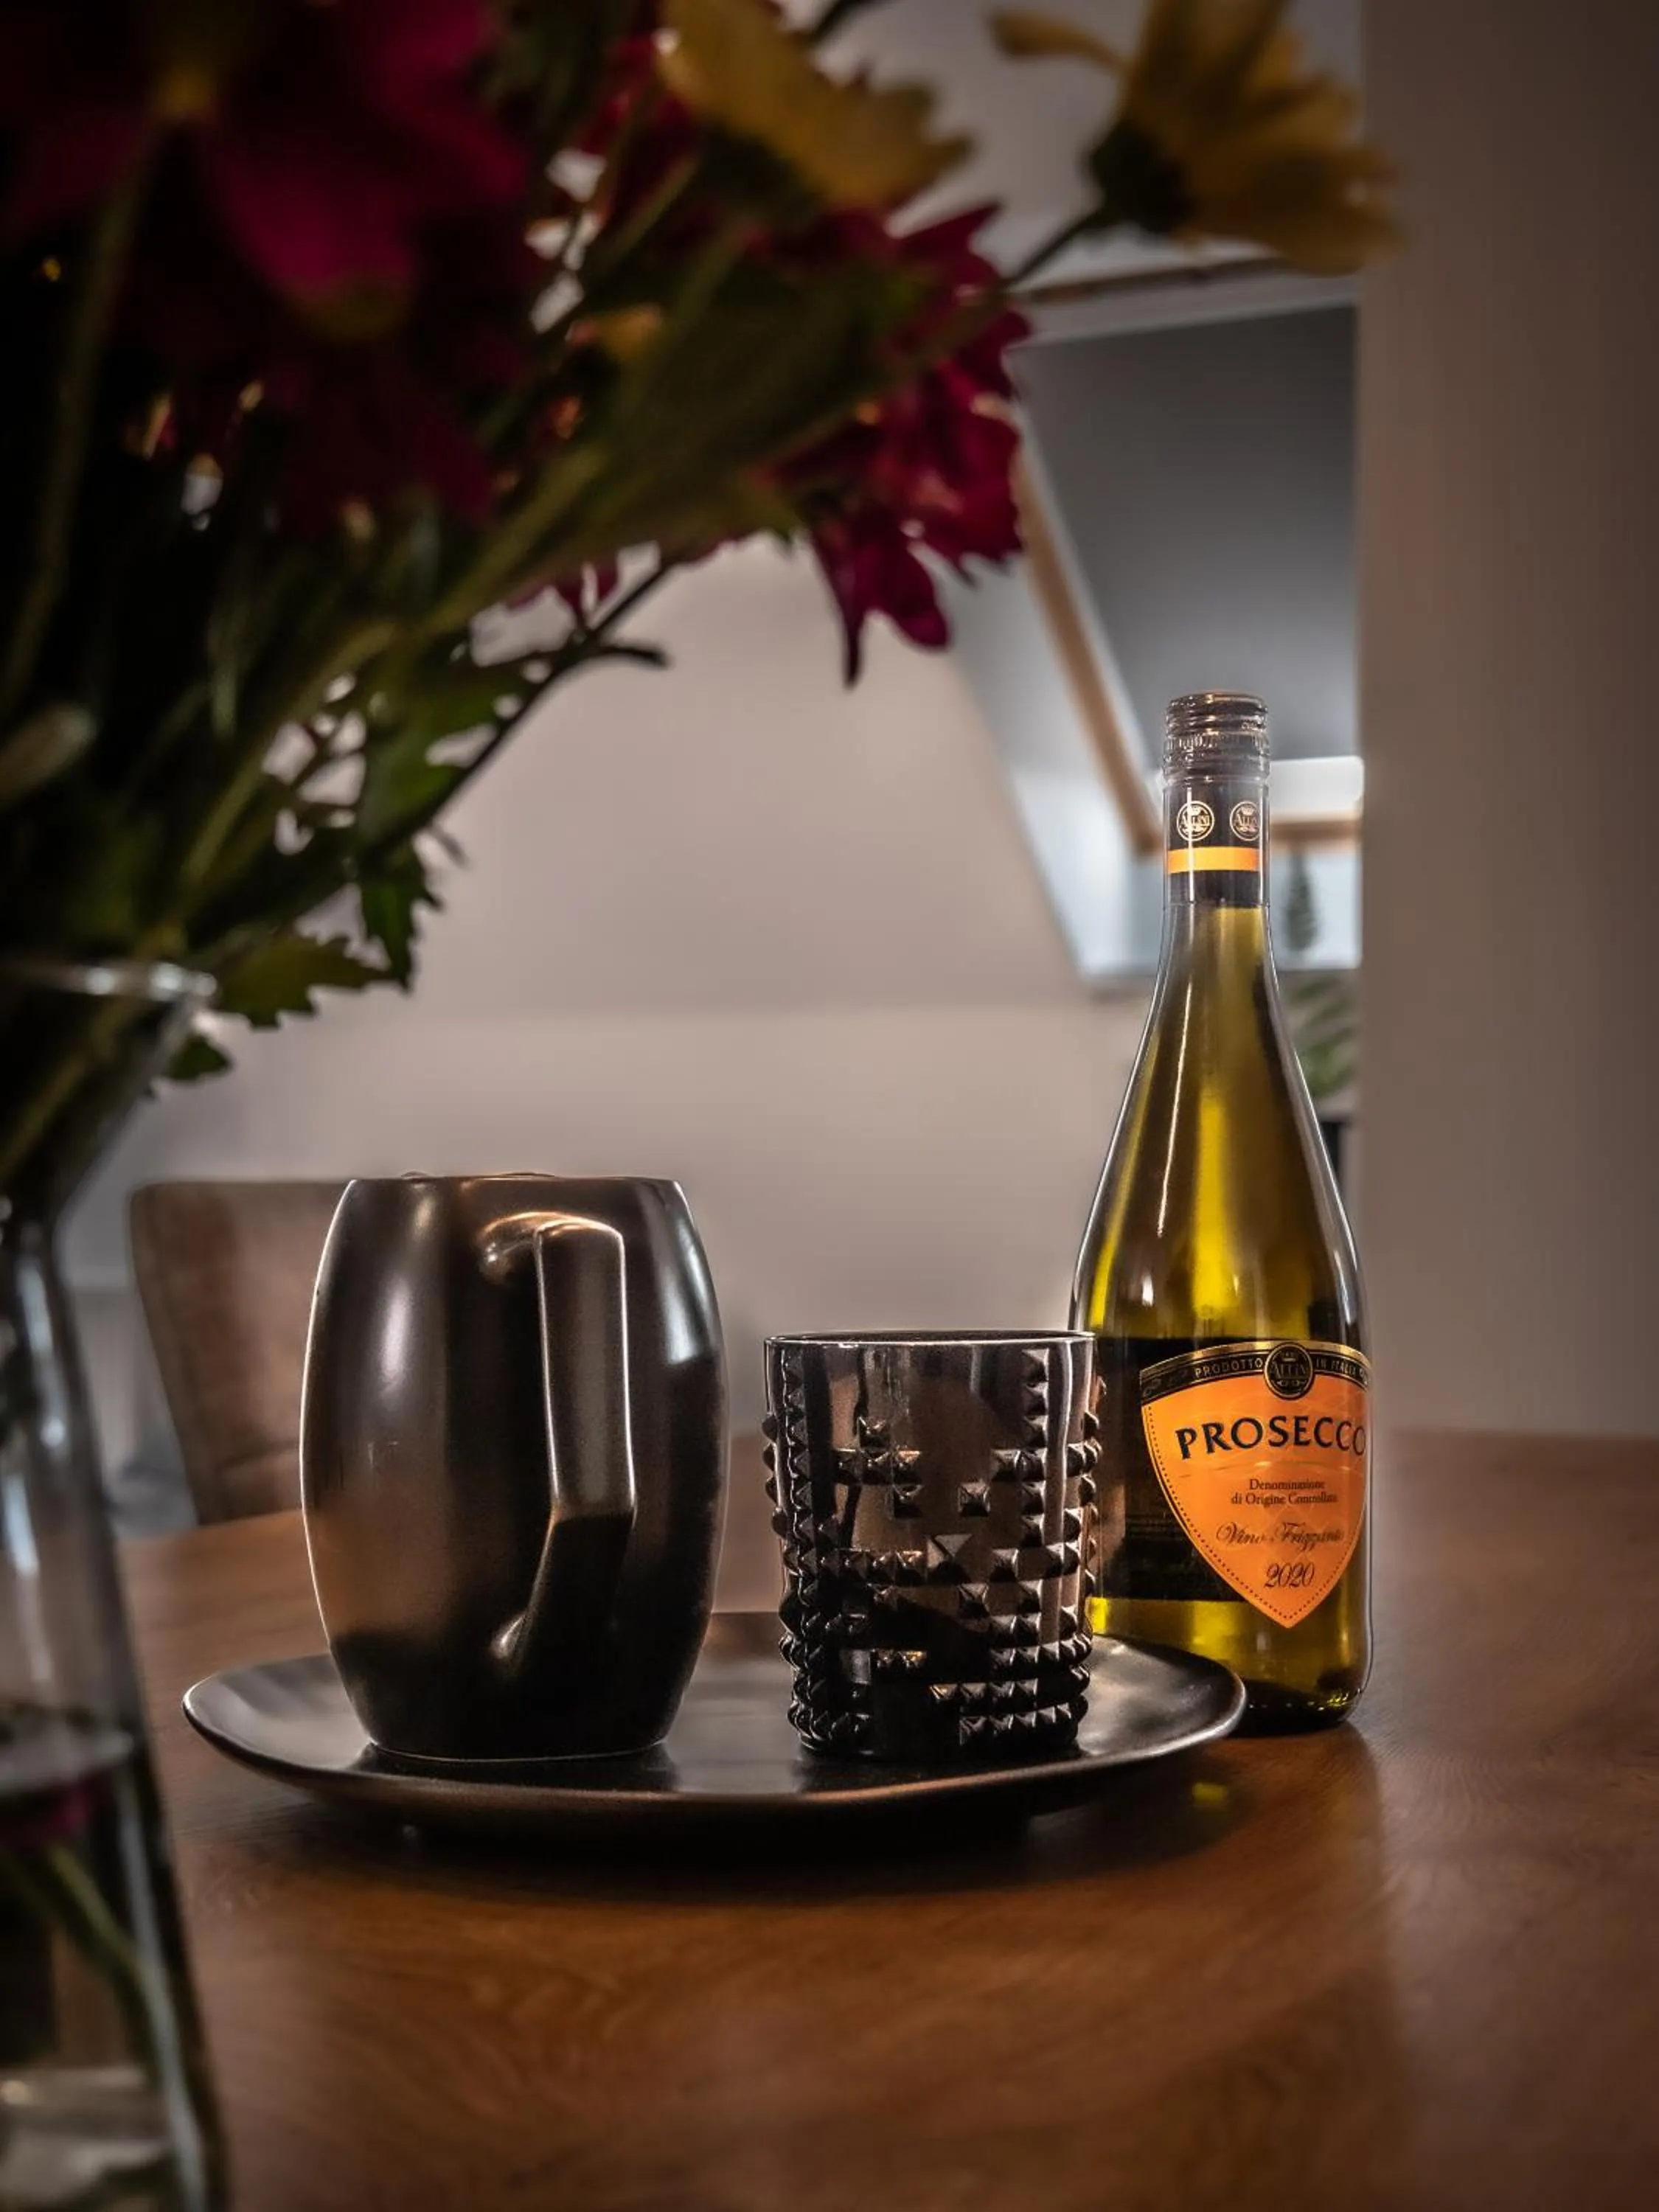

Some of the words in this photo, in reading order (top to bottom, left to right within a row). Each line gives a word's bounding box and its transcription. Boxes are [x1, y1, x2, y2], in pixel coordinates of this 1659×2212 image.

[1194, 1357, 1263, 1378] PRODOTTO
[1315, 1357, 1327, 1369] IN
[1331, 1360, 1357, 1377] ITALIA
[1175, 1415, 1366, 1460] PROSECCO
[1231, 1492, 1242, 1505] di
[1245, 1492, 1286, 1508] Origine
[1216, 1521, 1265, 1545] Vino
[1264, 1562, 1315, 1587] 2020
